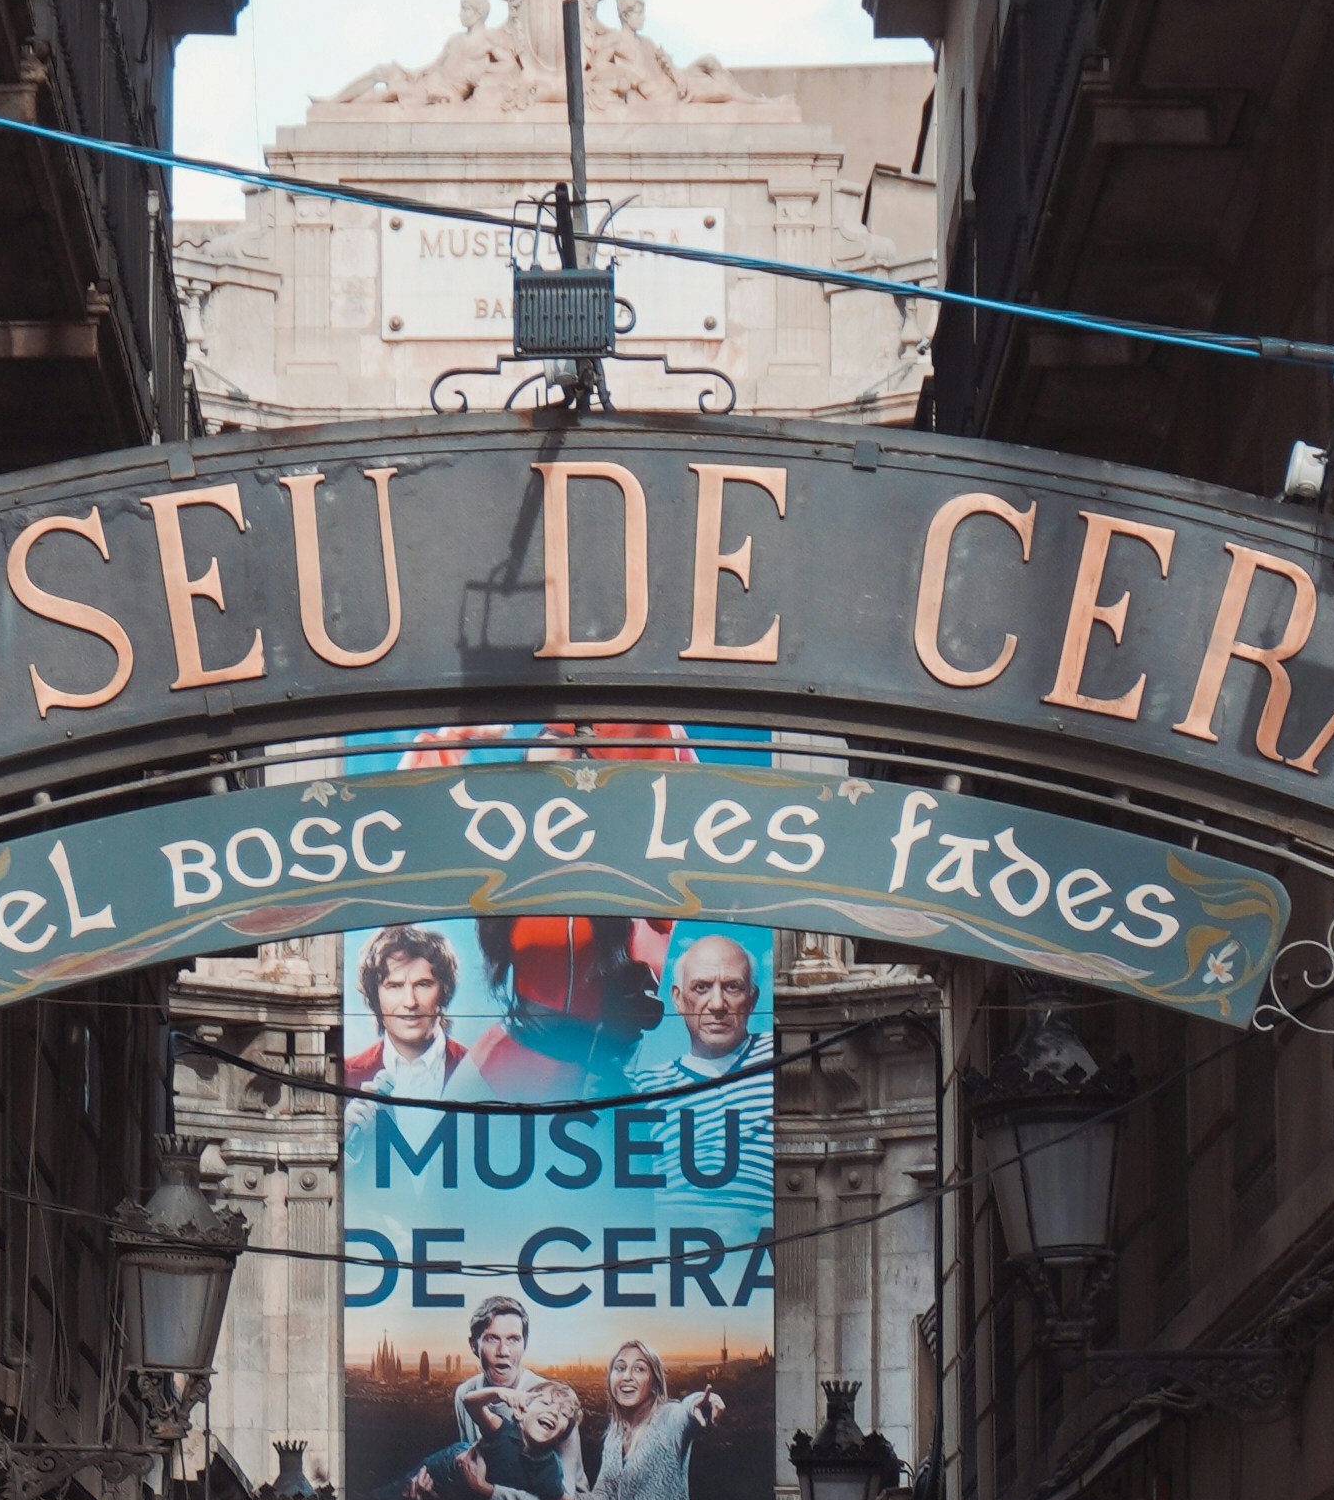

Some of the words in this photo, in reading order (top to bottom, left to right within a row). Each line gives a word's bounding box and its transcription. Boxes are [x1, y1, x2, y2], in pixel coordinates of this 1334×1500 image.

[529, 460, 788, 664] DE
[374, 1107, 740, 1190] MUSEU
[344, 1227, 466, 1308] DE
[519, 1226, 774, 1308] CERA
